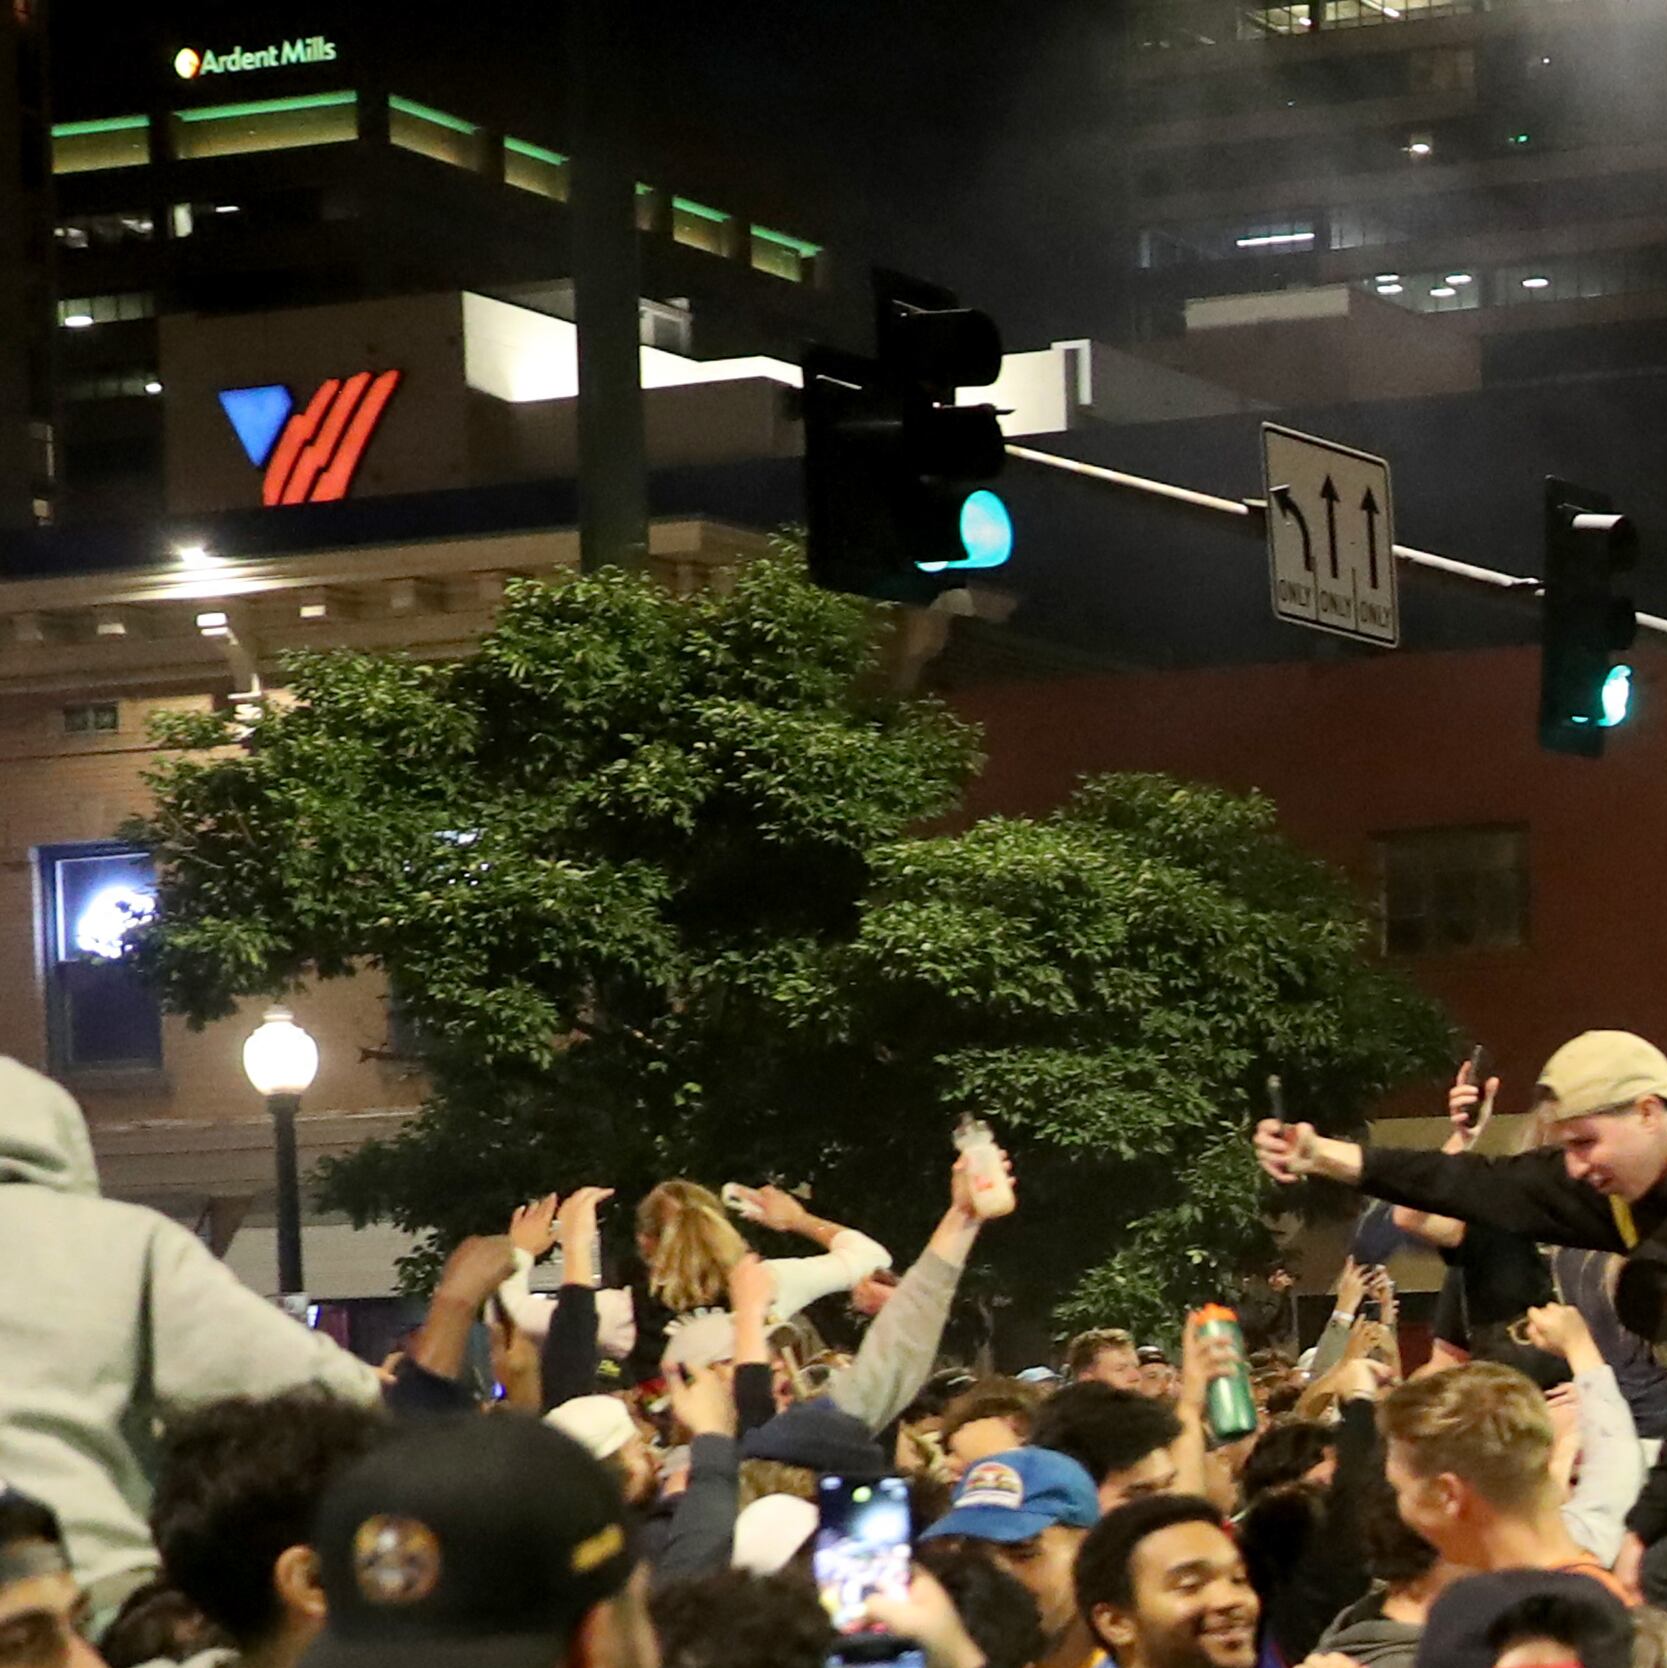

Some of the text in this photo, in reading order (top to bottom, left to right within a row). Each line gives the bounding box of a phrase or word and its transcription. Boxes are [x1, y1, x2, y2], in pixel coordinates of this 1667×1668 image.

[199, 35, 338, 76] Ardent Mills
[1279, 578, 1312, 608] ONLY
[1319, 589, 1352, 619] ONLY
[1359, 600, 1392, 629] ONLY
